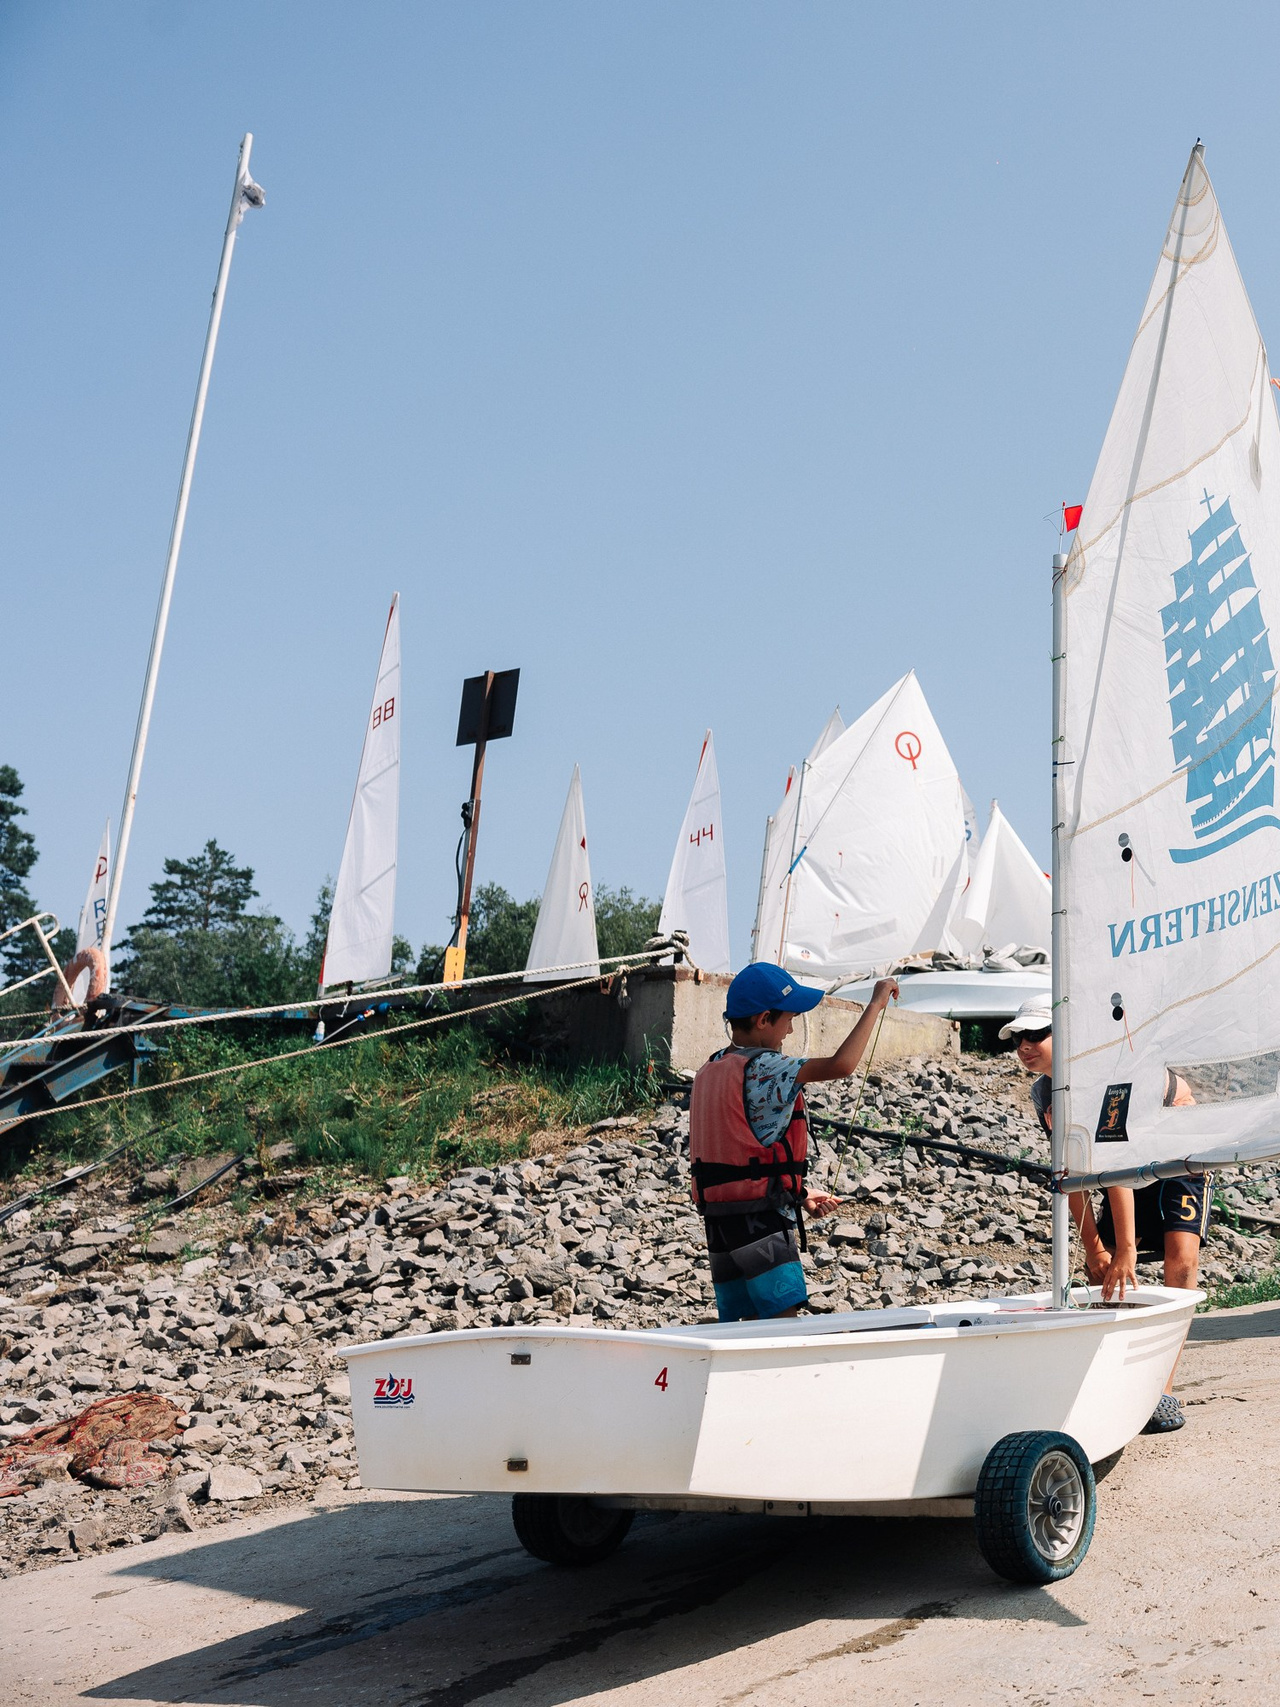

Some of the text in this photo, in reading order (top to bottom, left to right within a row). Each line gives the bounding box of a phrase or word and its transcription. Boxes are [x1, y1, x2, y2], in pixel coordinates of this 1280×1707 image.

[372, 697, 395, 730] 88
[690, 823, 713, 847] 44
[1180, 1195, 1197, 1221] 5
[654, 1366, 668, 1392] 4
